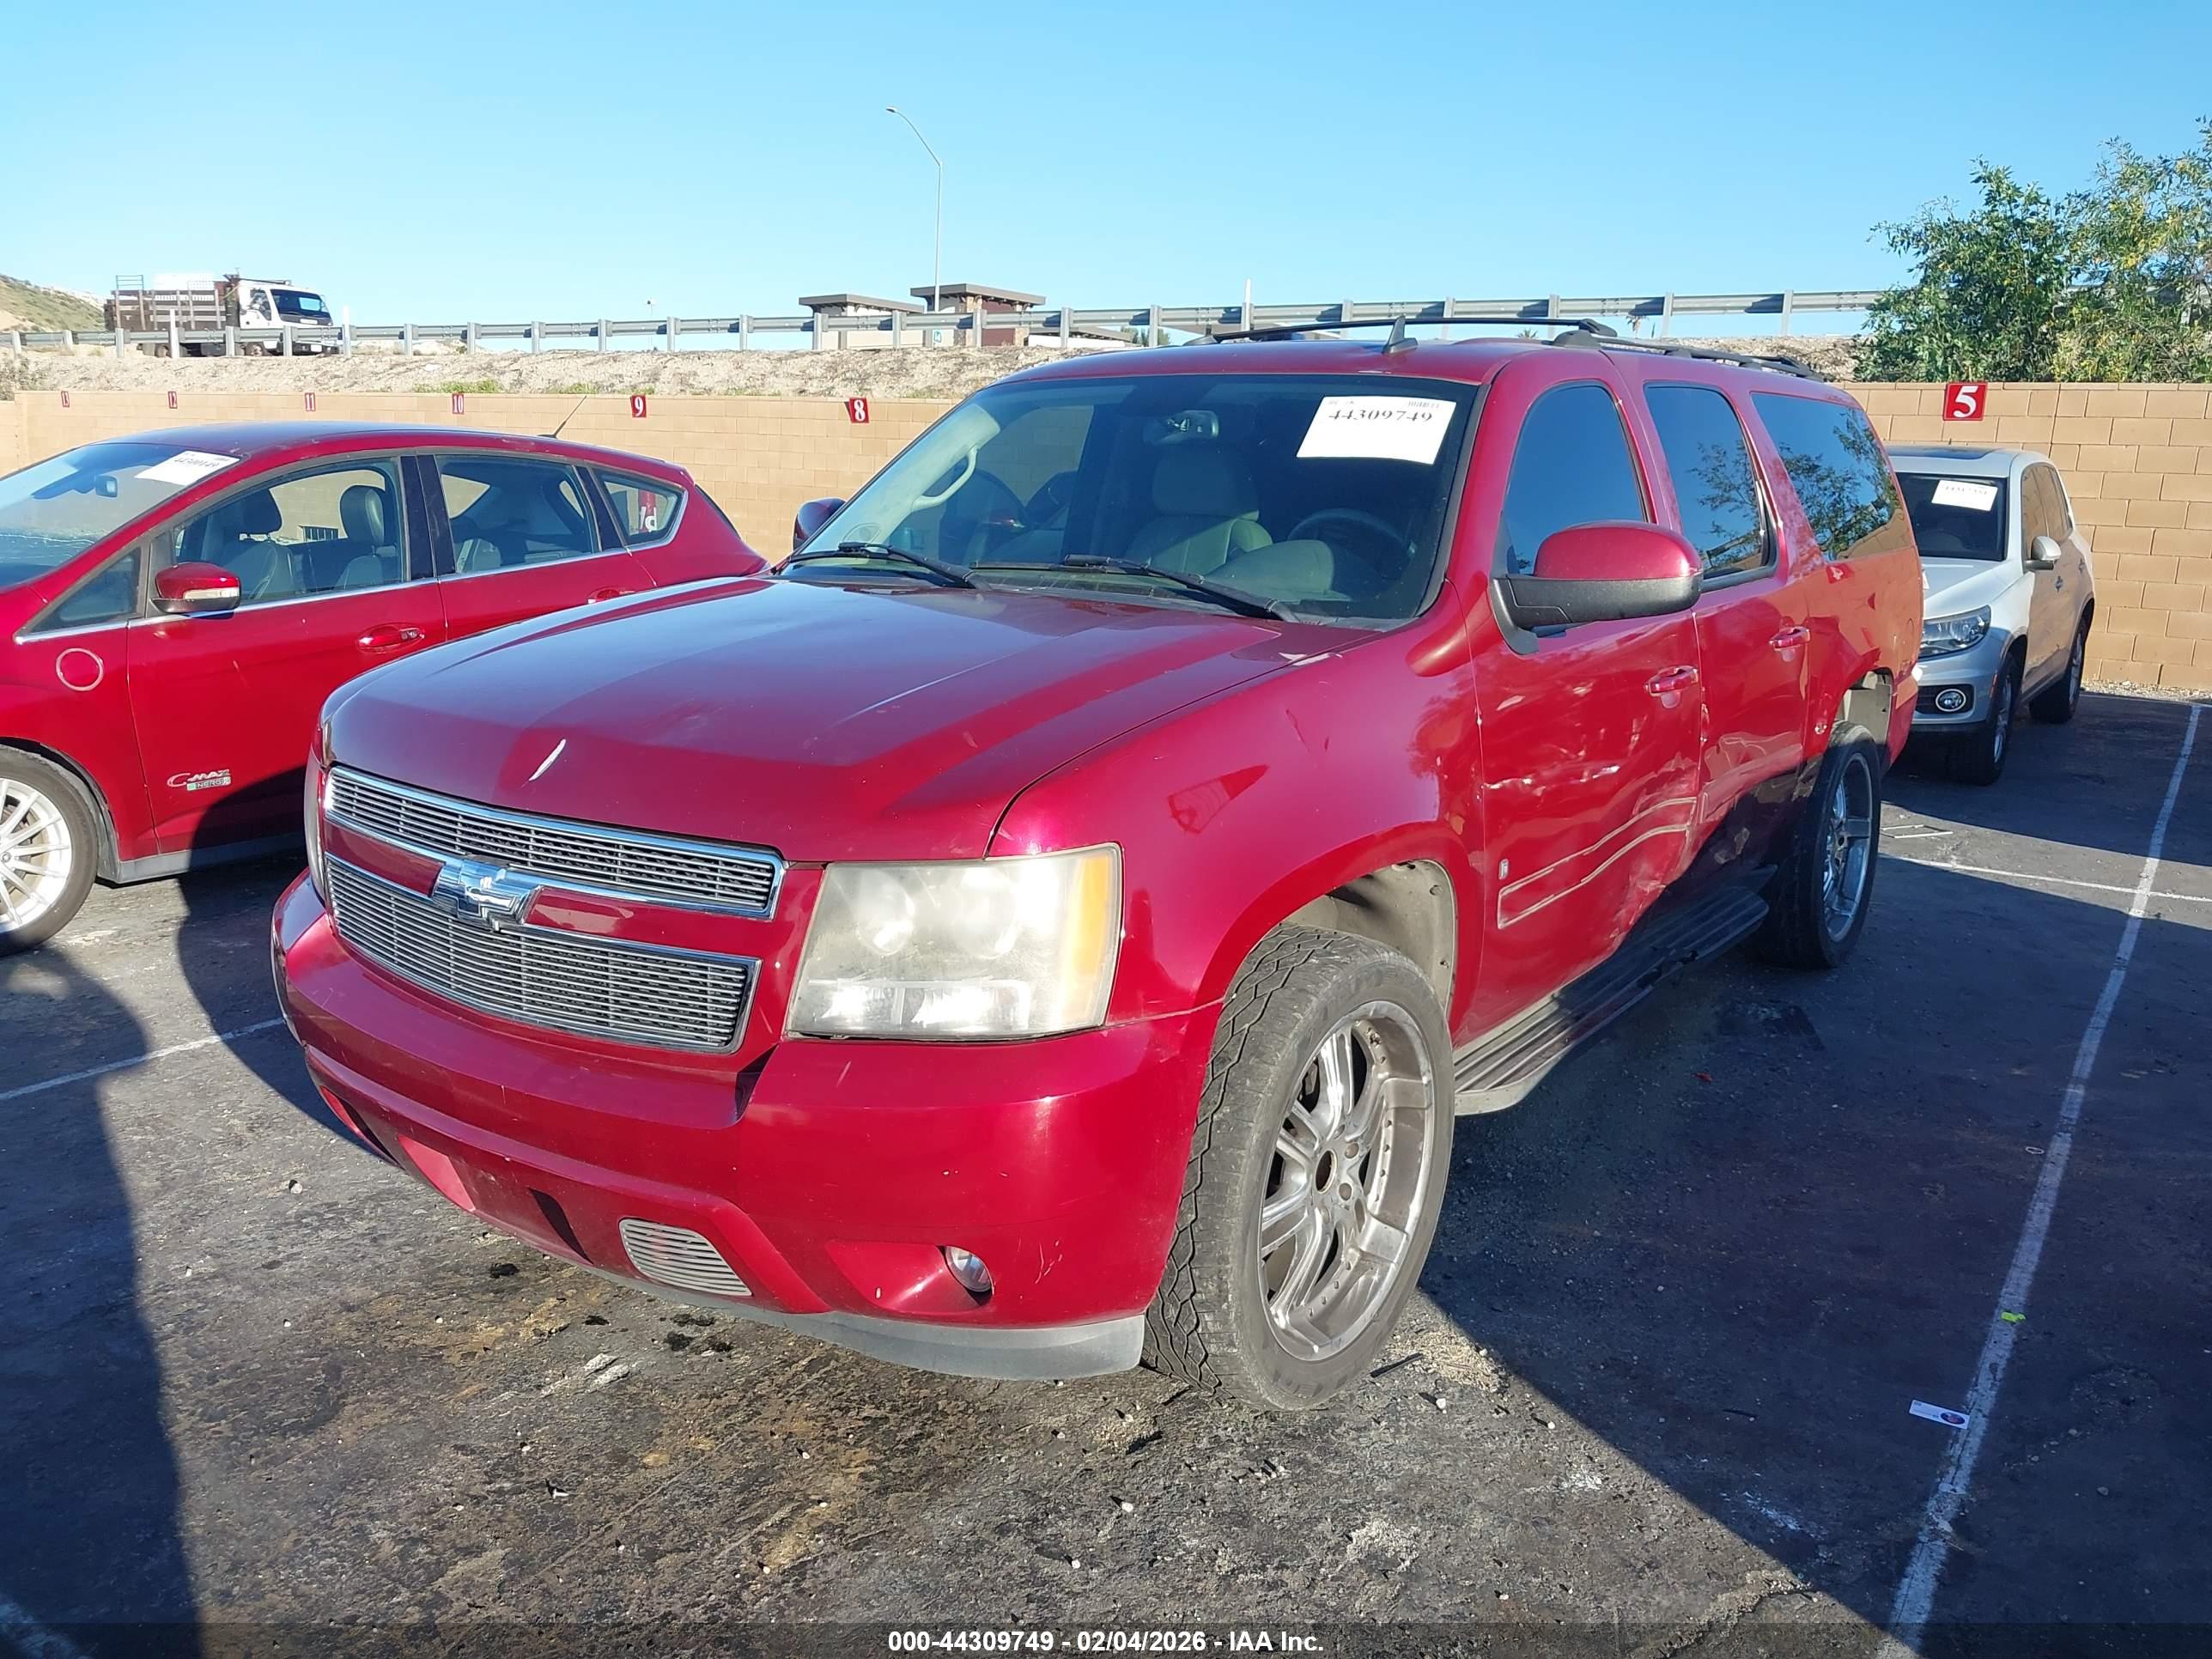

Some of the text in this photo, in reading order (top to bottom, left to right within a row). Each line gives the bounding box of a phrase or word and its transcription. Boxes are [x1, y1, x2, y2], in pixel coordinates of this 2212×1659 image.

[305, 393, 315, 411] 11
[453, 395, 464, 414] 10
[635, 396, 644, 416] 9
[854, 398, 866, 422] 8
[1953, 385, 1978, 418] 5
[1328, 409, 1433, 422] 44309749
